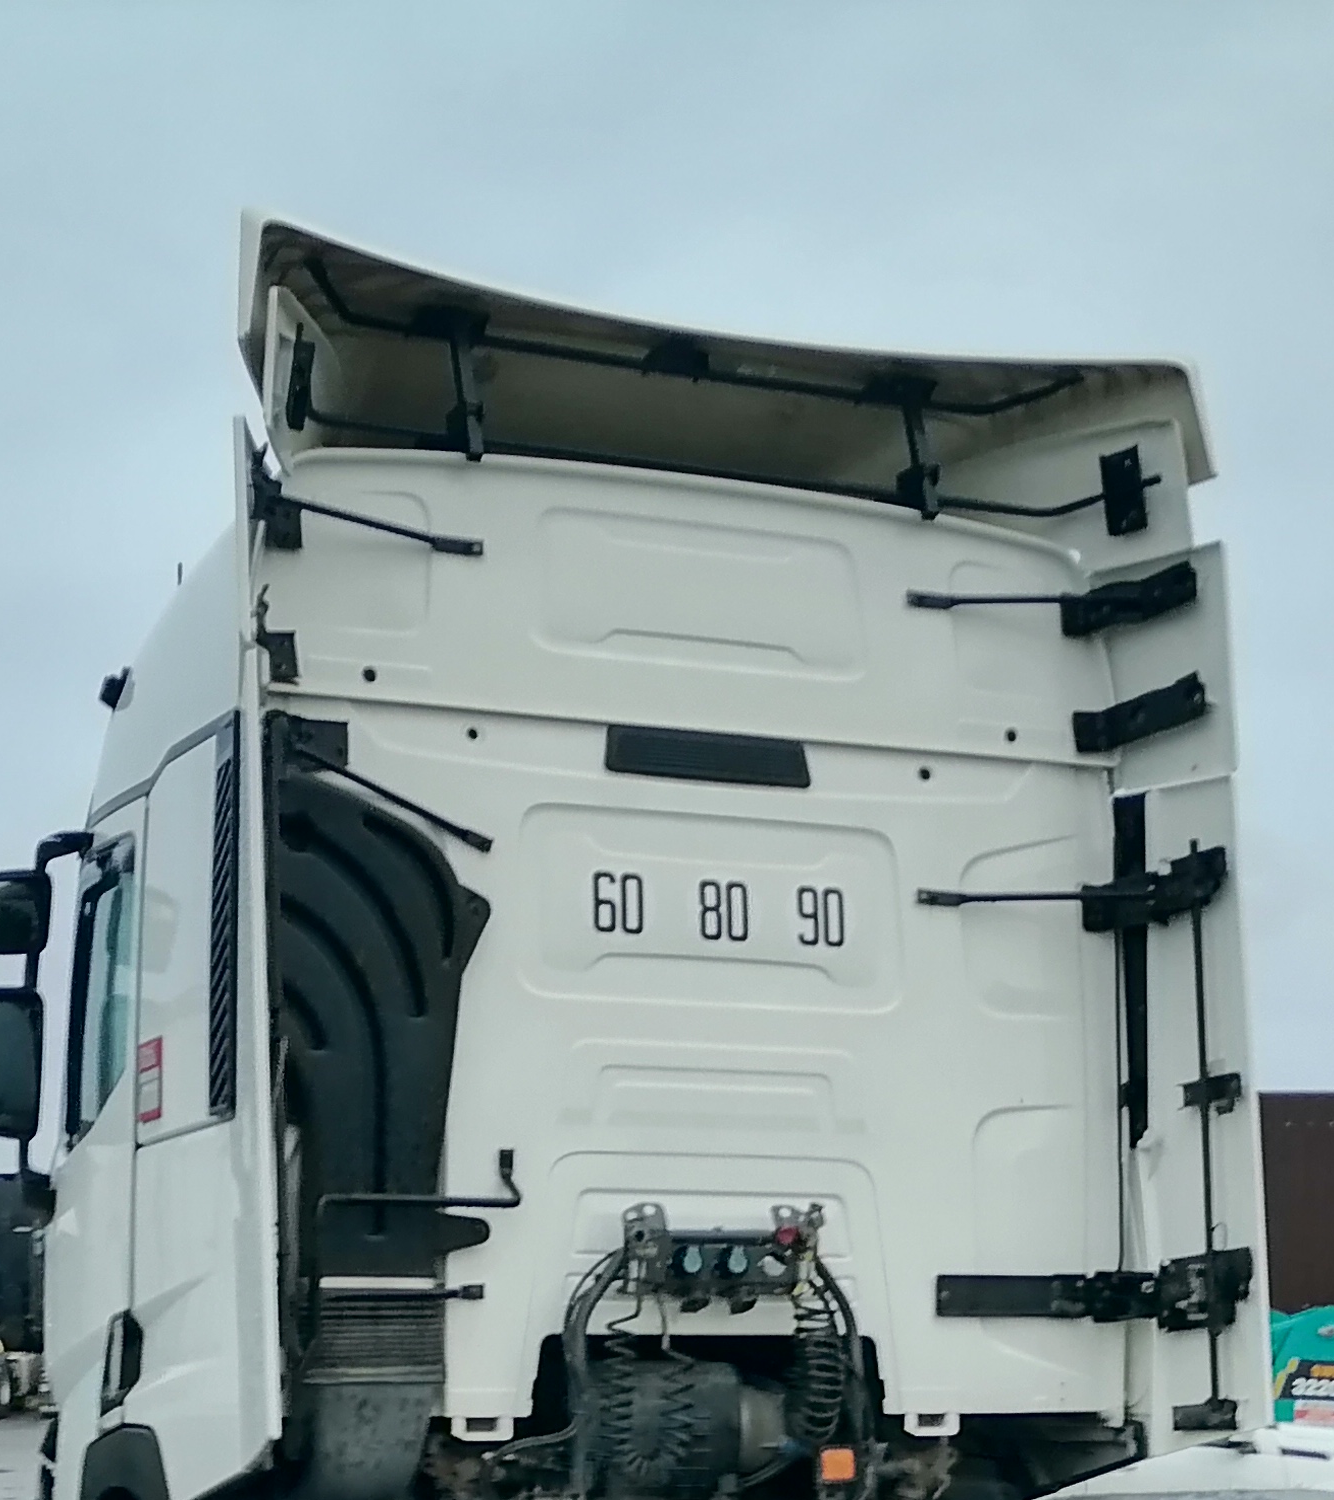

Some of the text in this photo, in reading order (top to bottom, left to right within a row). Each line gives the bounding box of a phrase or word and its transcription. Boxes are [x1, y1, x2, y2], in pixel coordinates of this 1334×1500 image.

[592, 871, 845, 947] 60 80 90
